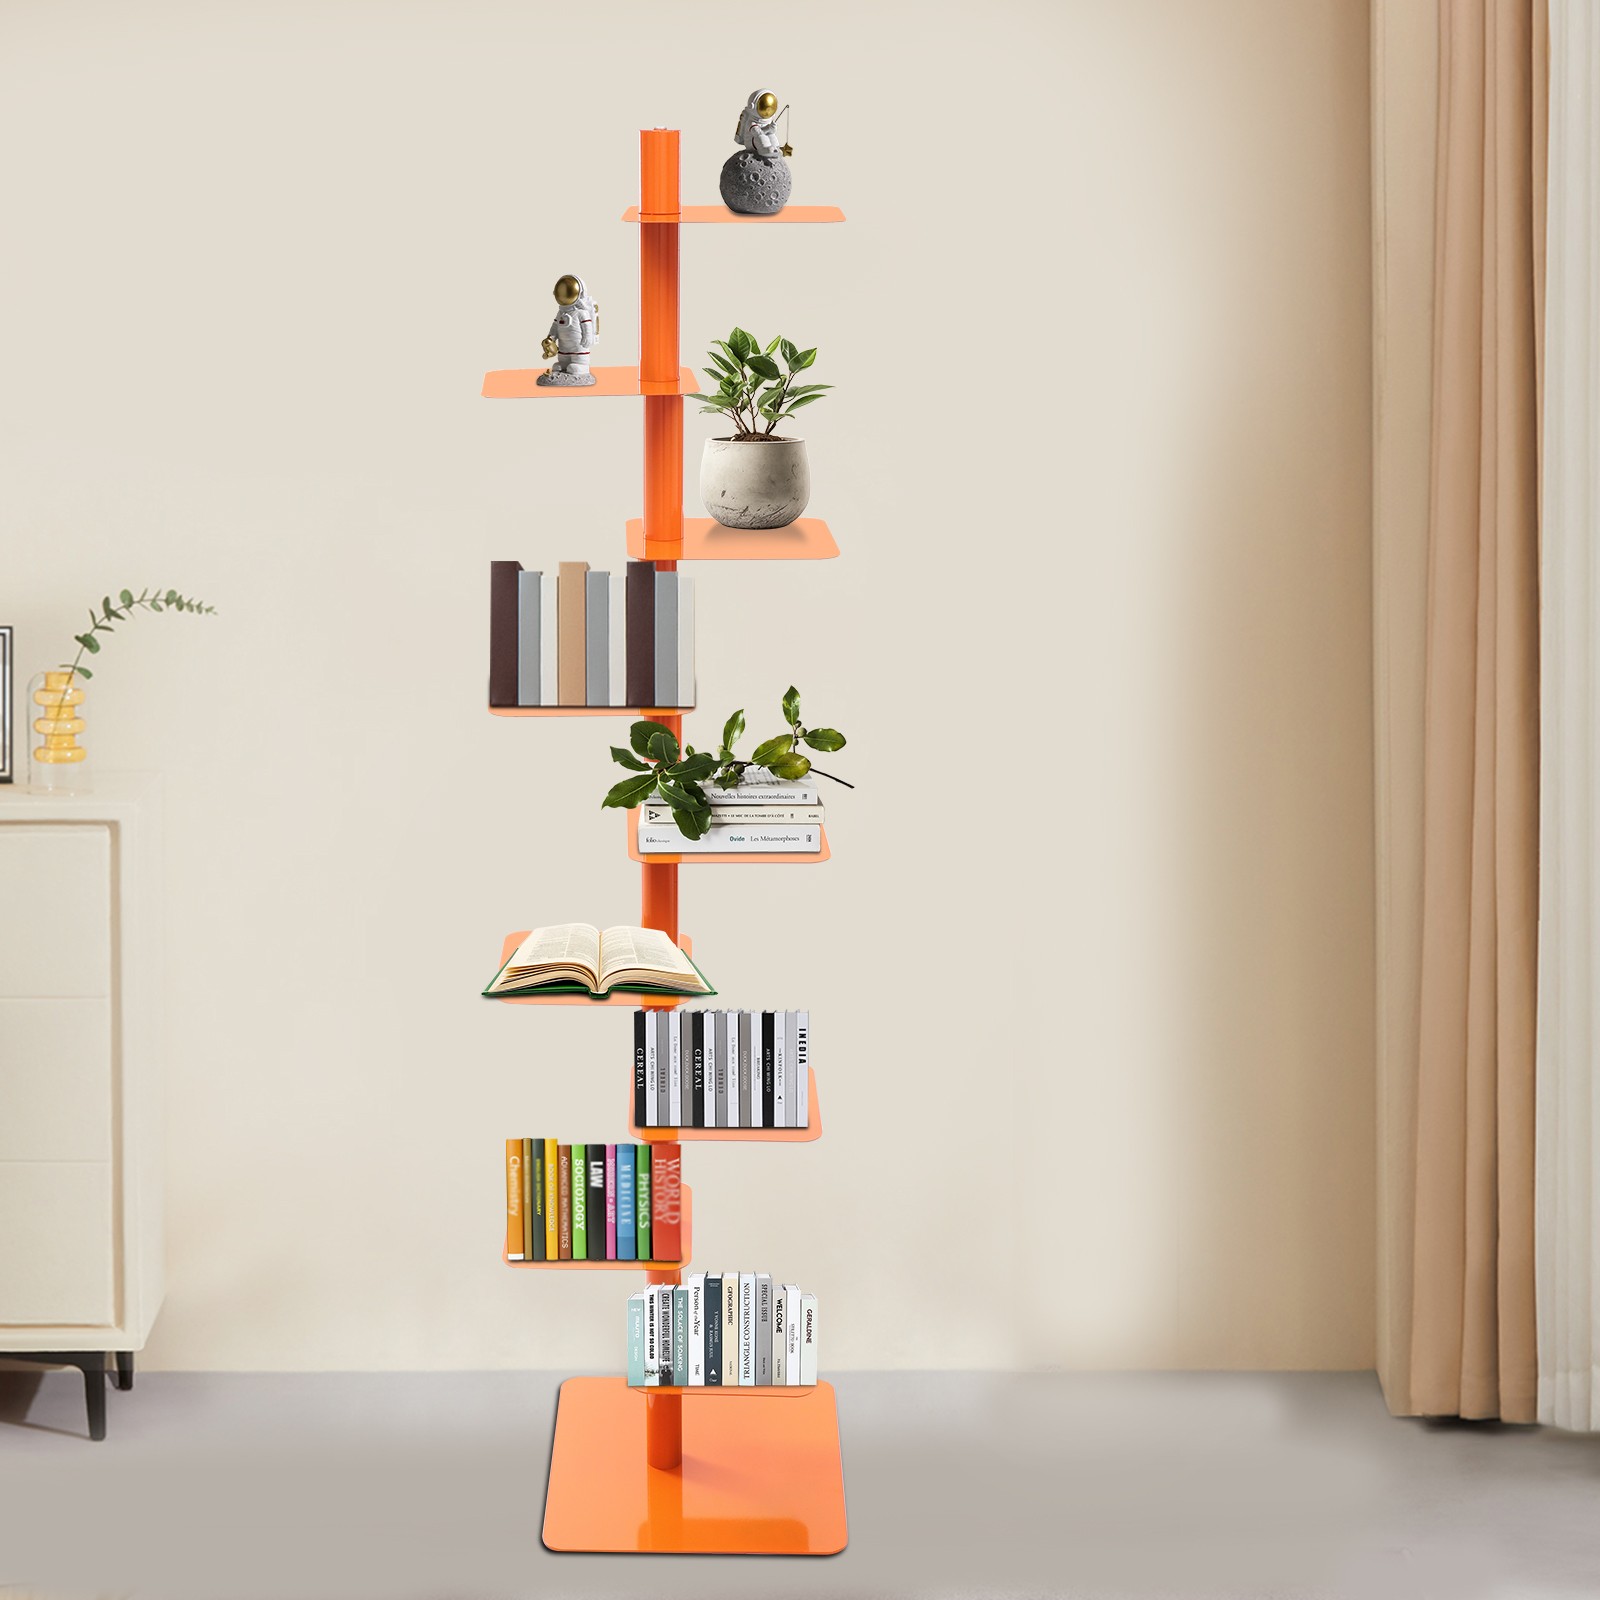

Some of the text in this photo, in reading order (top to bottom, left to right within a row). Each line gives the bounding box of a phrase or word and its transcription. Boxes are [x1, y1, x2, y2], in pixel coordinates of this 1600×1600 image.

[508, 1156, 520, 1216] Chemistry
[575, 1159, 584, 1230] SOCIOLOGY
[591, 1161, 603, 1188] LAW
[621, 1164, 631, 1224] MEDICINE
[639, 1173, 650, 1229] PHYSICS
[655, 1159, 668, 1223] HISTORY
[666, 1158, 680, 1224] WORLD
